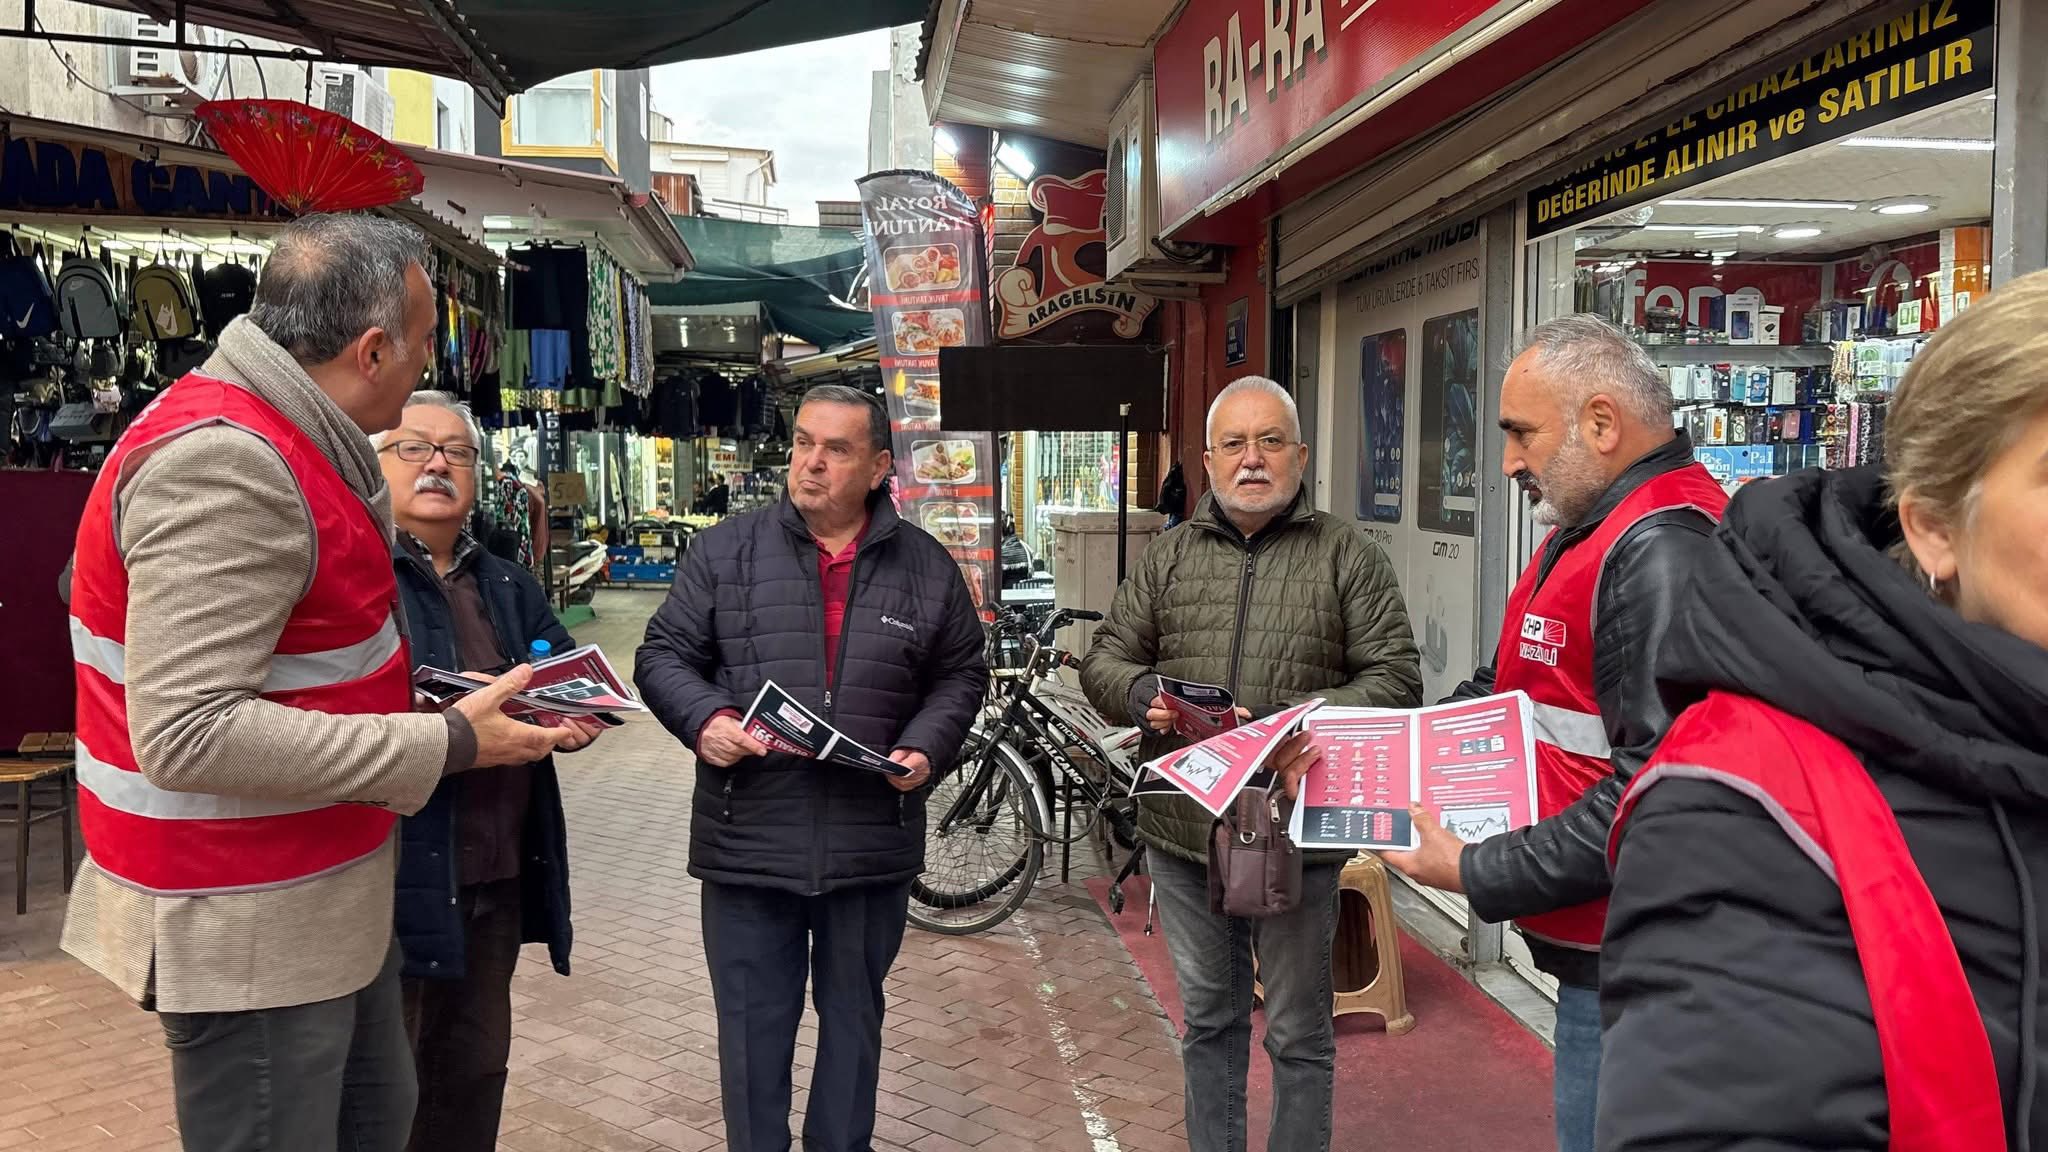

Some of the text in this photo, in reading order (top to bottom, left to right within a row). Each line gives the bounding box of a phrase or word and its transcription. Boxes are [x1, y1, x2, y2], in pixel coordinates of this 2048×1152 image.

[1537, 157, 1656, 224] DEĞERİNDE
[1664, 119, 1757, 179] ALINIR
[1769, 108, 1805, 141] ve
[1817, 38, 1973, 124] SATILIR
[1456, 258, 1480, 284] FIRS
[1448, 543, 1460, 559] 20
[1056, 722, 1097, 756] MOSTAR
[1035, 736, 1084, 784] SALCANO
